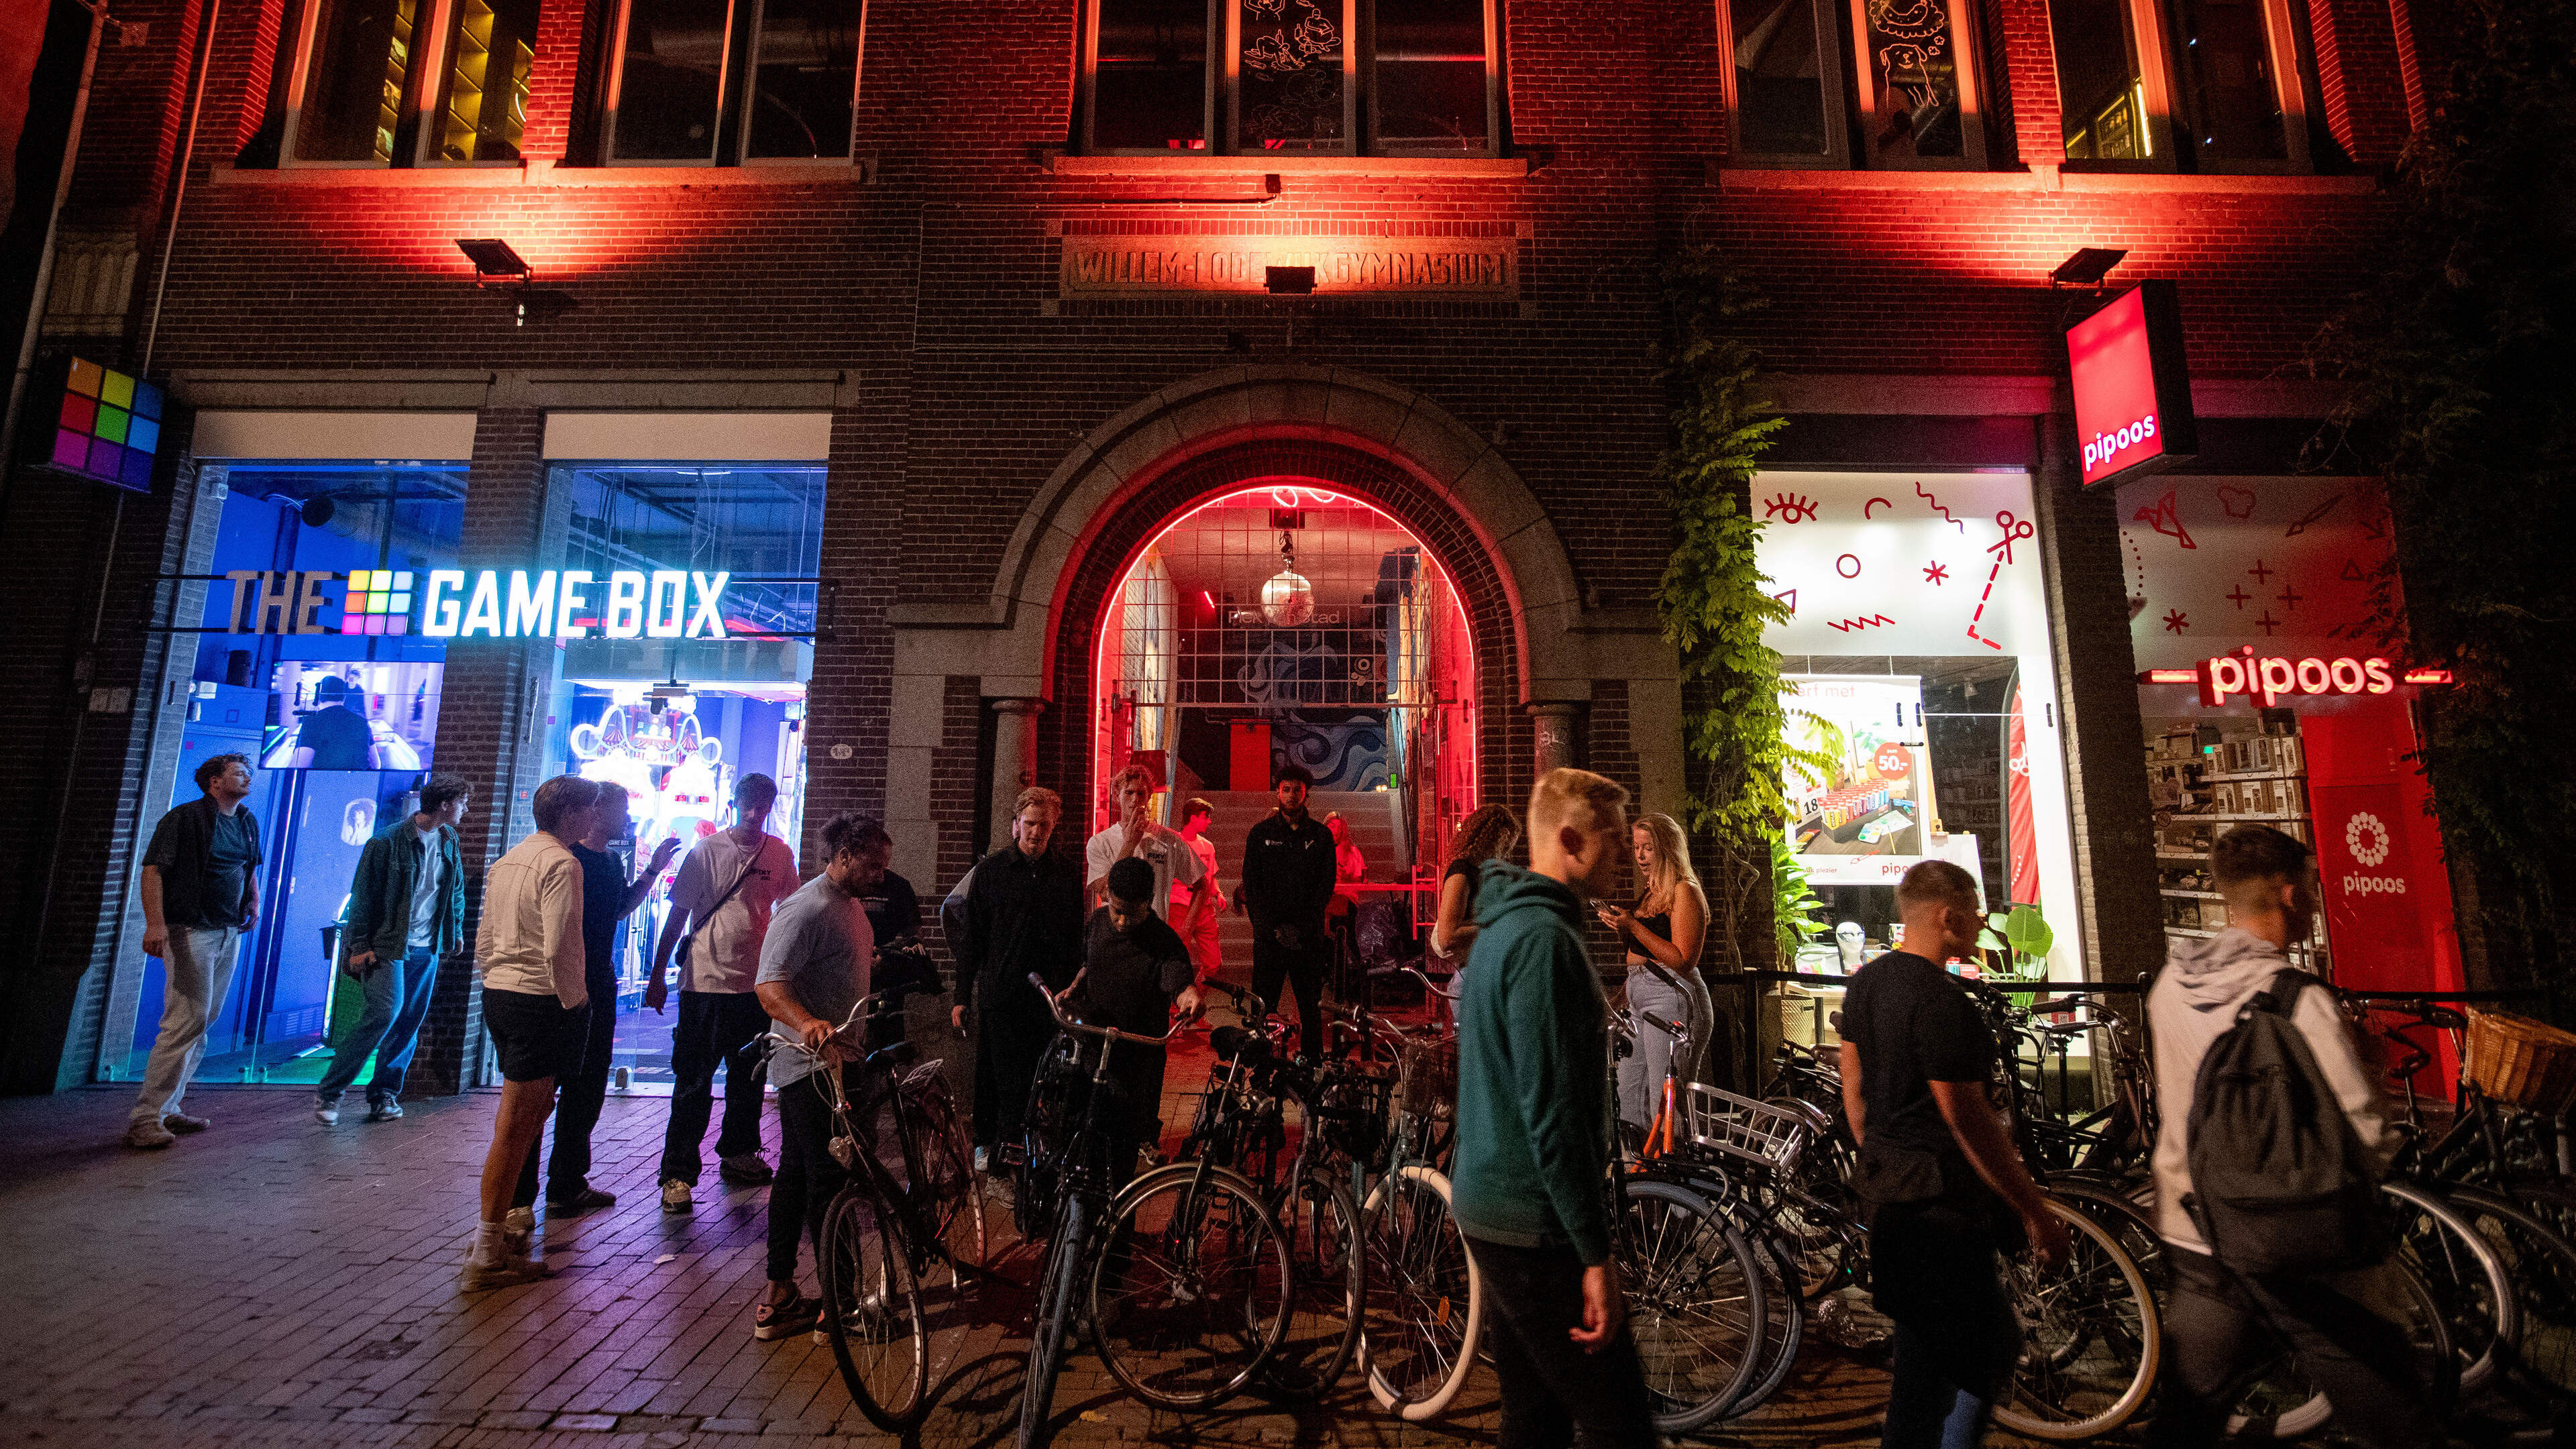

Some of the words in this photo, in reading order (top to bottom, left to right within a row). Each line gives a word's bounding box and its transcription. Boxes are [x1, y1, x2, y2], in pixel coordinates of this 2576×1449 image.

[2084, 415, 2155, 472] pipoos
[225, 570, 333, 635] THE
[422, 570, 593, 637] GAME
[605, 570, 730, 638] BOX
[2209, 645, 2394, 708] pipoos
[1825, 686, 1855, 697] met
[1878, 755, 1909, 771] 50.-
[1882, 863, 1911, 875] pipo
[2343, 871, 2406, 897] pipoos
